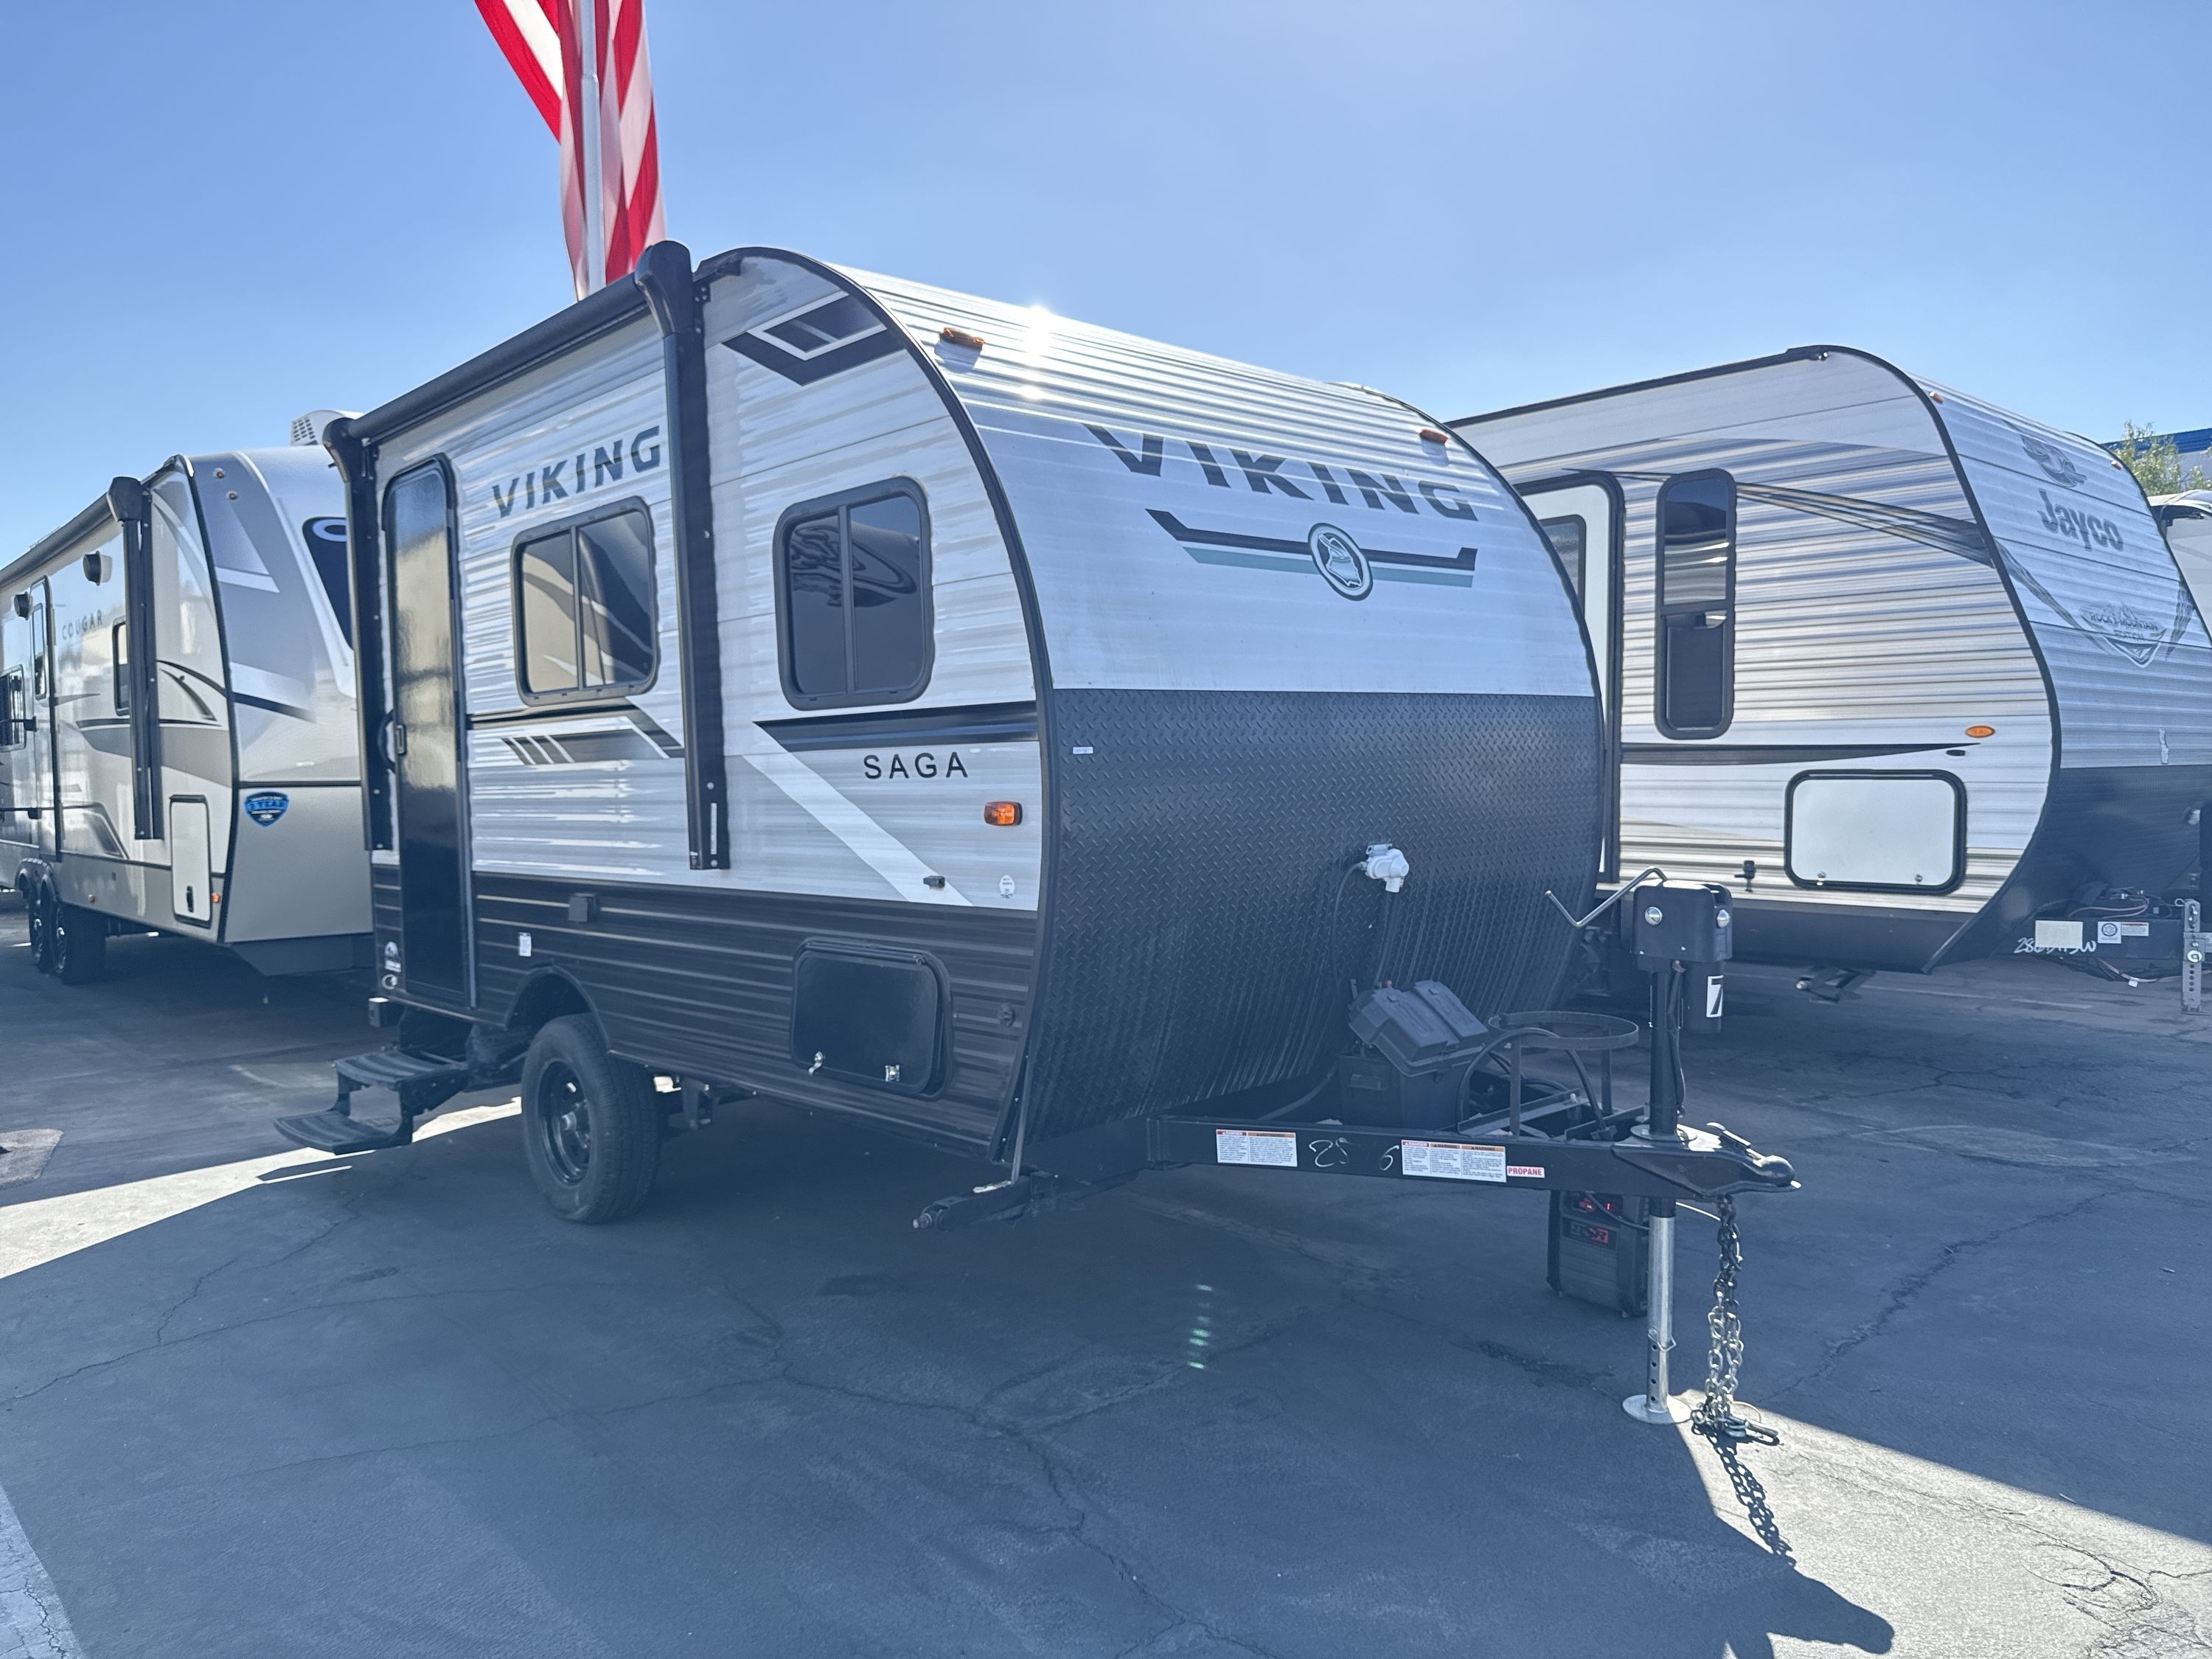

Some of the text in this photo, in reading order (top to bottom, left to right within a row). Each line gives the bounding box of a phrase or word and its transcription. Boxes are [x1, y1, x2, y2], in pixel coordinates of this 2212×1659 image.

[492, 425, 661, 518] VIKING
[1082, 422, 1478, 521] VIKING
[2037, 487, 2124, 552] Jayco
[62, 609, 102, 641] COUGAR
[863, 751, 968, 780] SAGA
[1508, 1167, 1543, 1176] PROPANE
